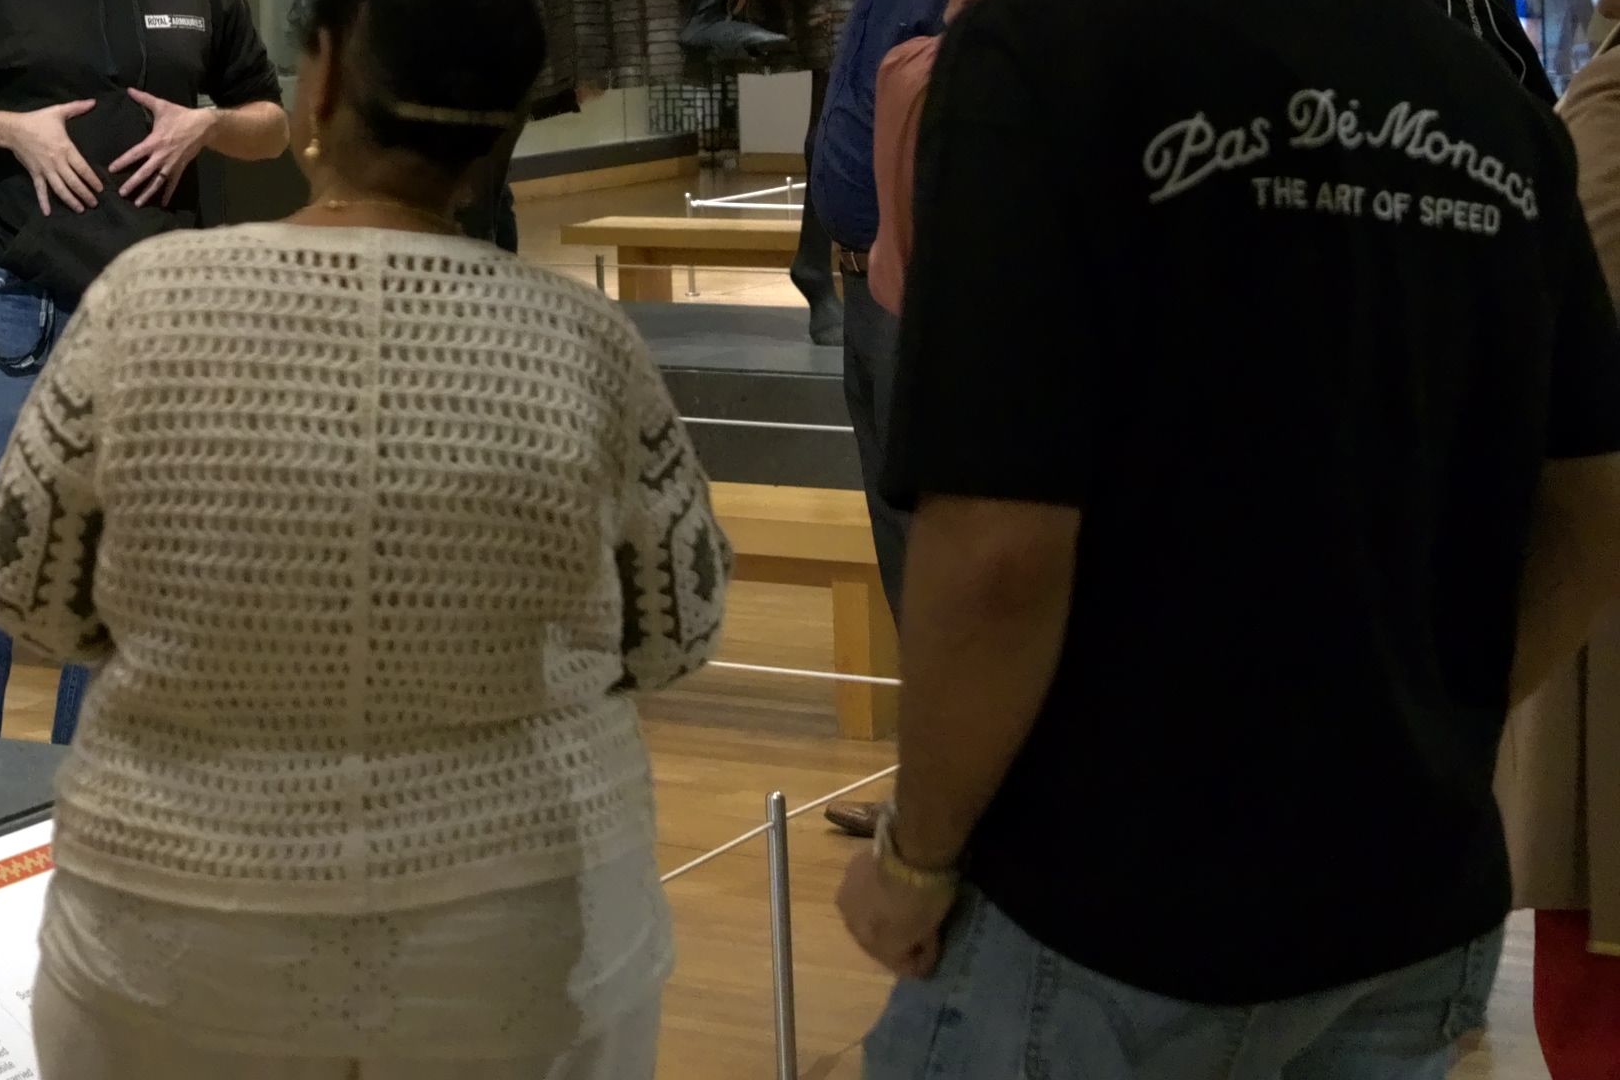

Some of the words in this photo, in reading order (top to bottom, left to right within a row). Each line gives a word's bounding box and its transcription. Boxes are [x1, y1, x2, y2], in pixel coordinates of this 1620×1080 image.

[147, 17, 167, 26] ROYAL
[1143, 111, 1271, 204] Pas
[1252, 177, 1308, 209] THE
[1316, 182, 1367, 217] ART
[1373, 190, 1412, 224] OF
[1418, 194, 1502, 236] SPEED
